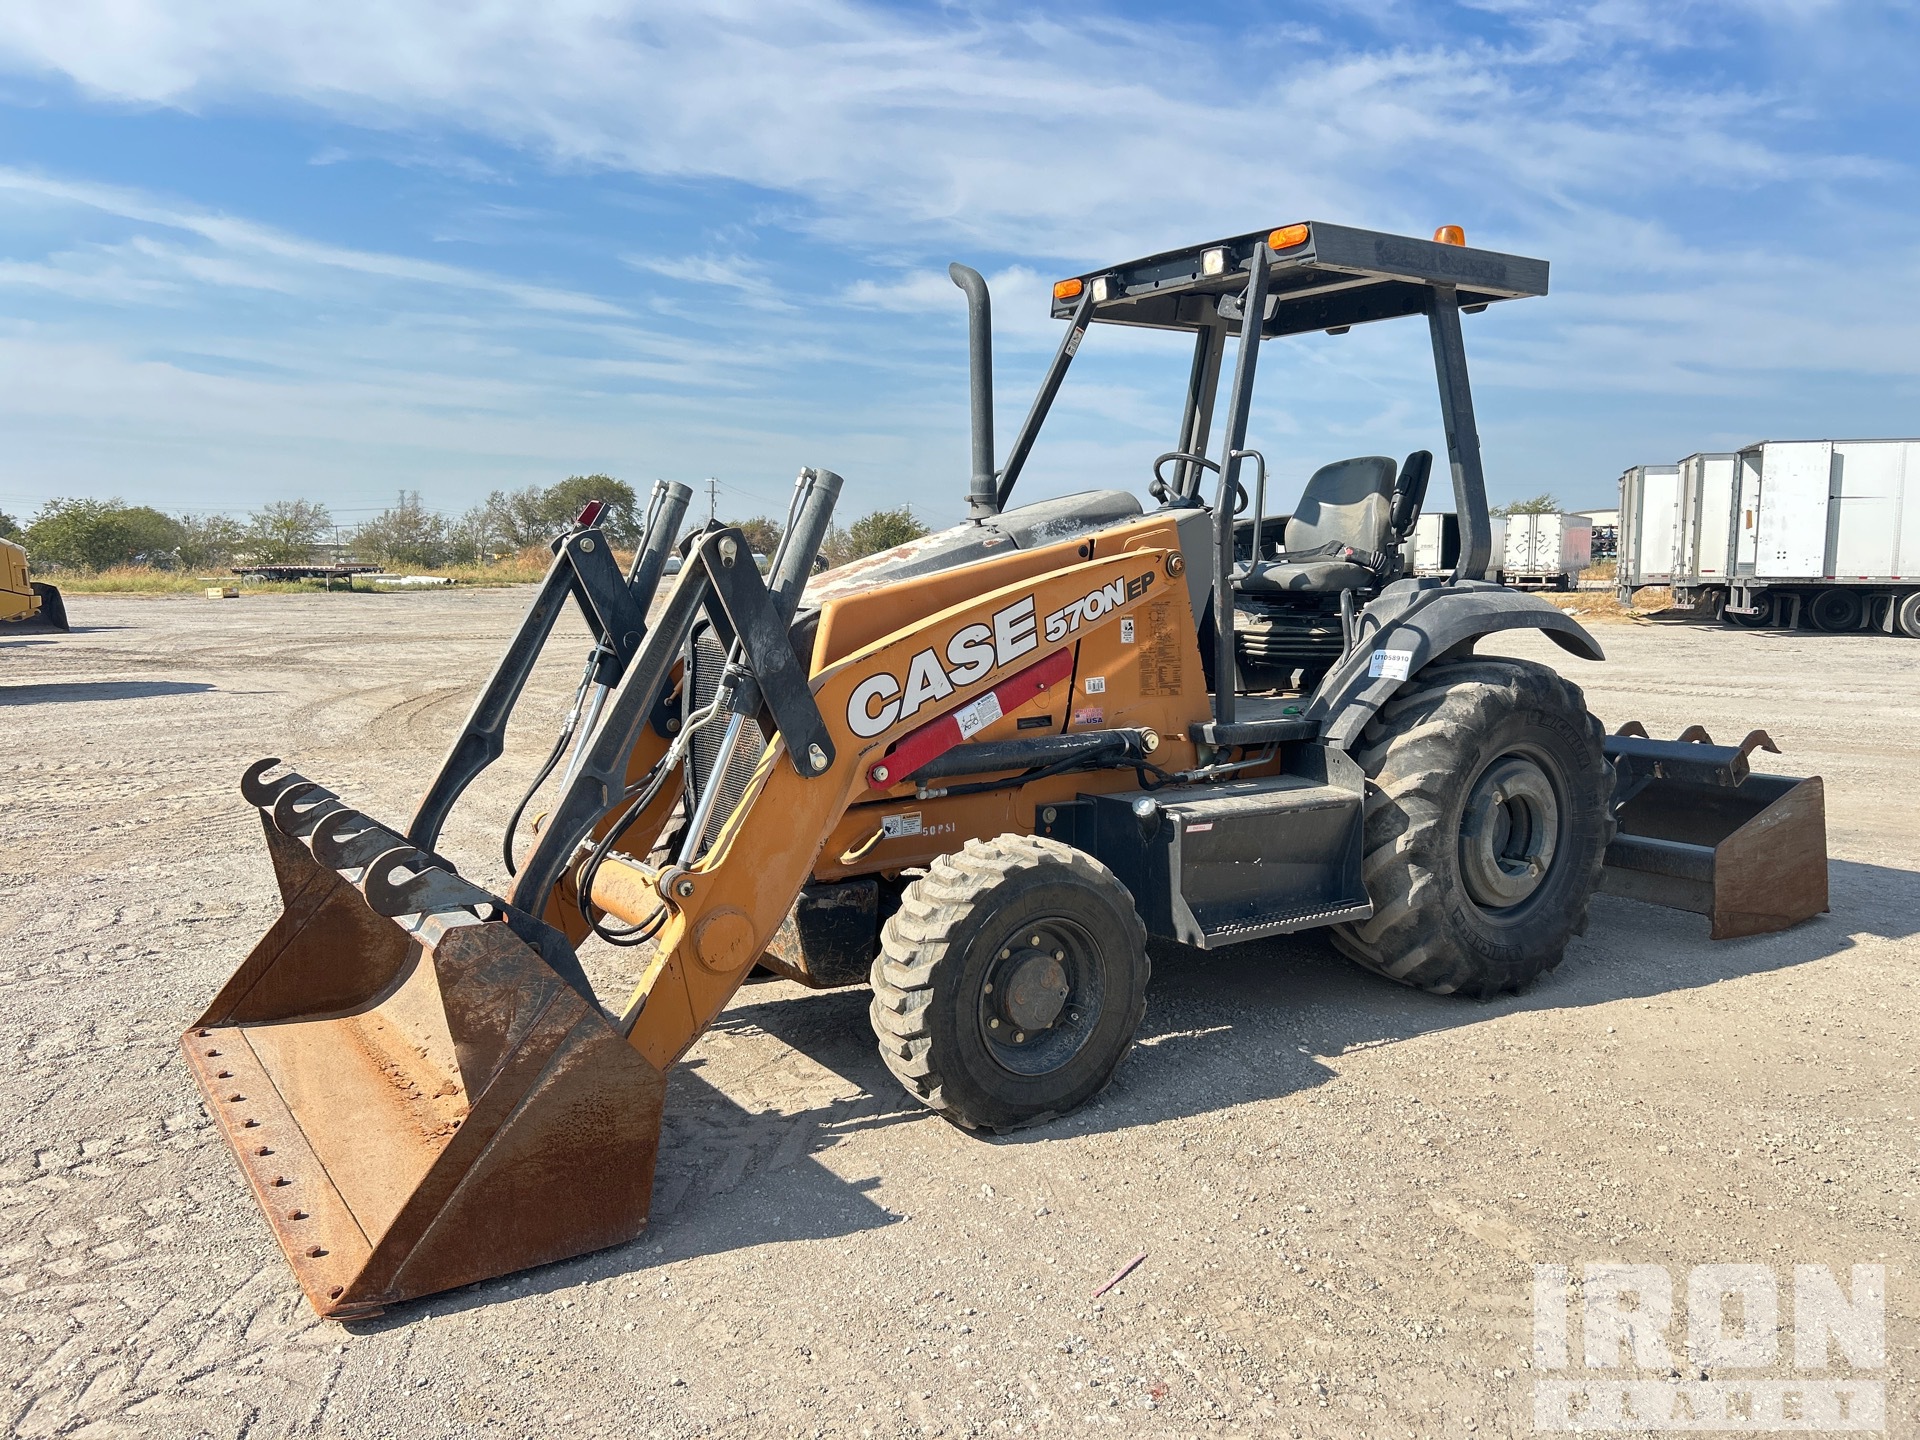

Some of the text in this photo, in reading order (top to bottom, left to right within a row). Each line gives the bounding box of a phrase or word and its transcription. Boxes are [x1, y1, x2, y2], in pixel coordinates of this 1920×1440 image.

[846, 594, 1039, 738] CASE
[1043, 576, 1127, 644] 570N
[1126, 570, 1156, 603] EP
